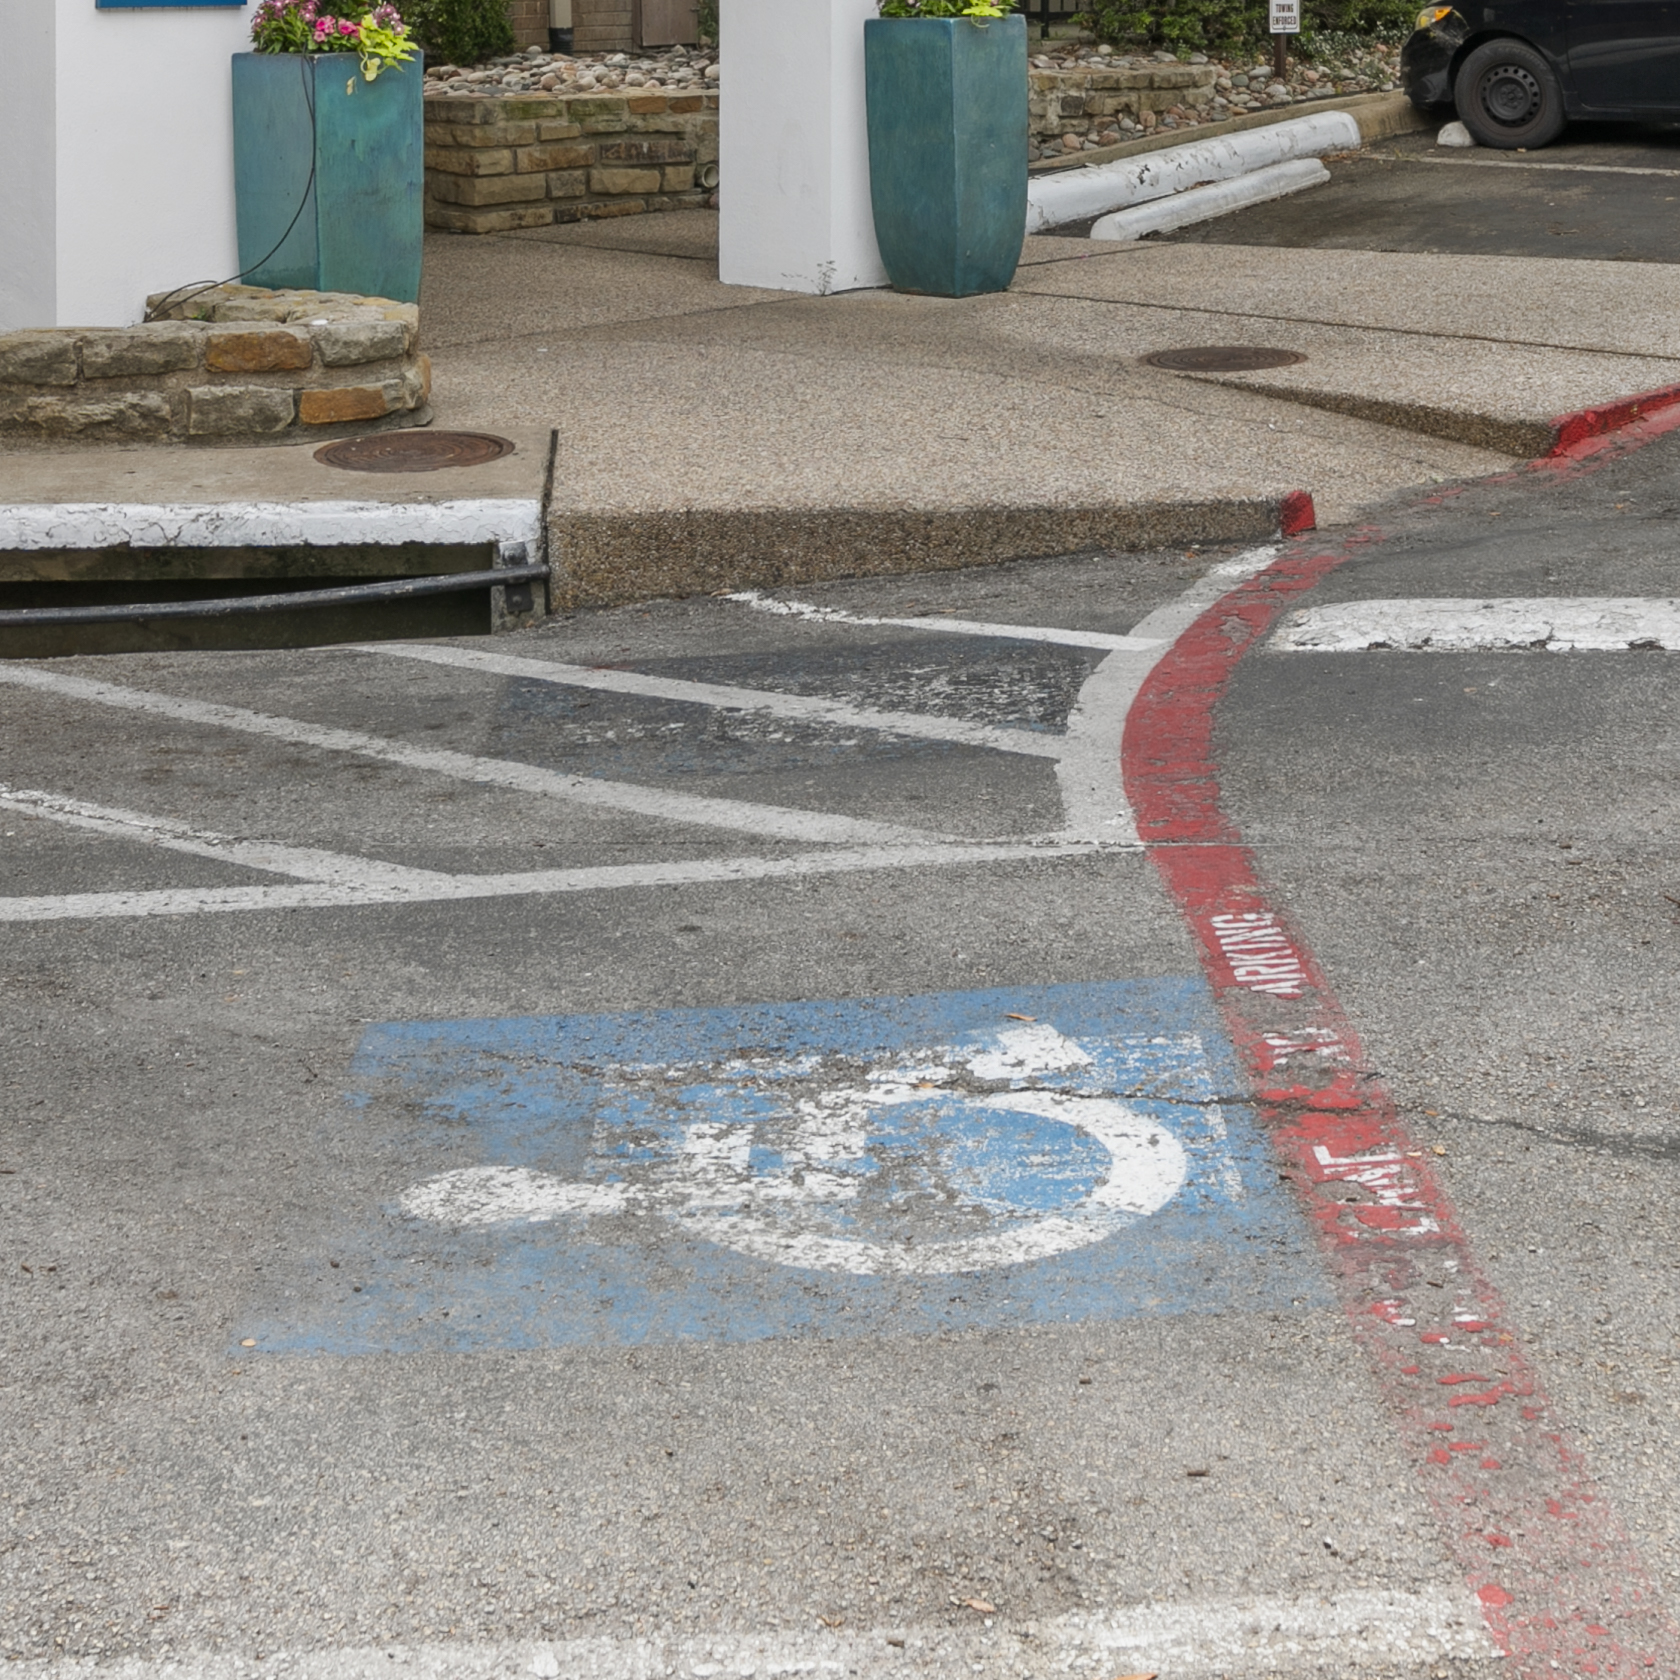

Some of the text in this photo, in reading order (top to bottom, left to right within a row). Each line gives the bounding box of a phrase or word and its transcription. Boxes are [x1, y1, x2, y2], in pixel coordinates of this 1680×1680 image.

[1275, 3, 1294, 13] TOWING
[1272, 16, 1297, 26] ENFORCED
[1210, 912, 1308, 995] ARKING
